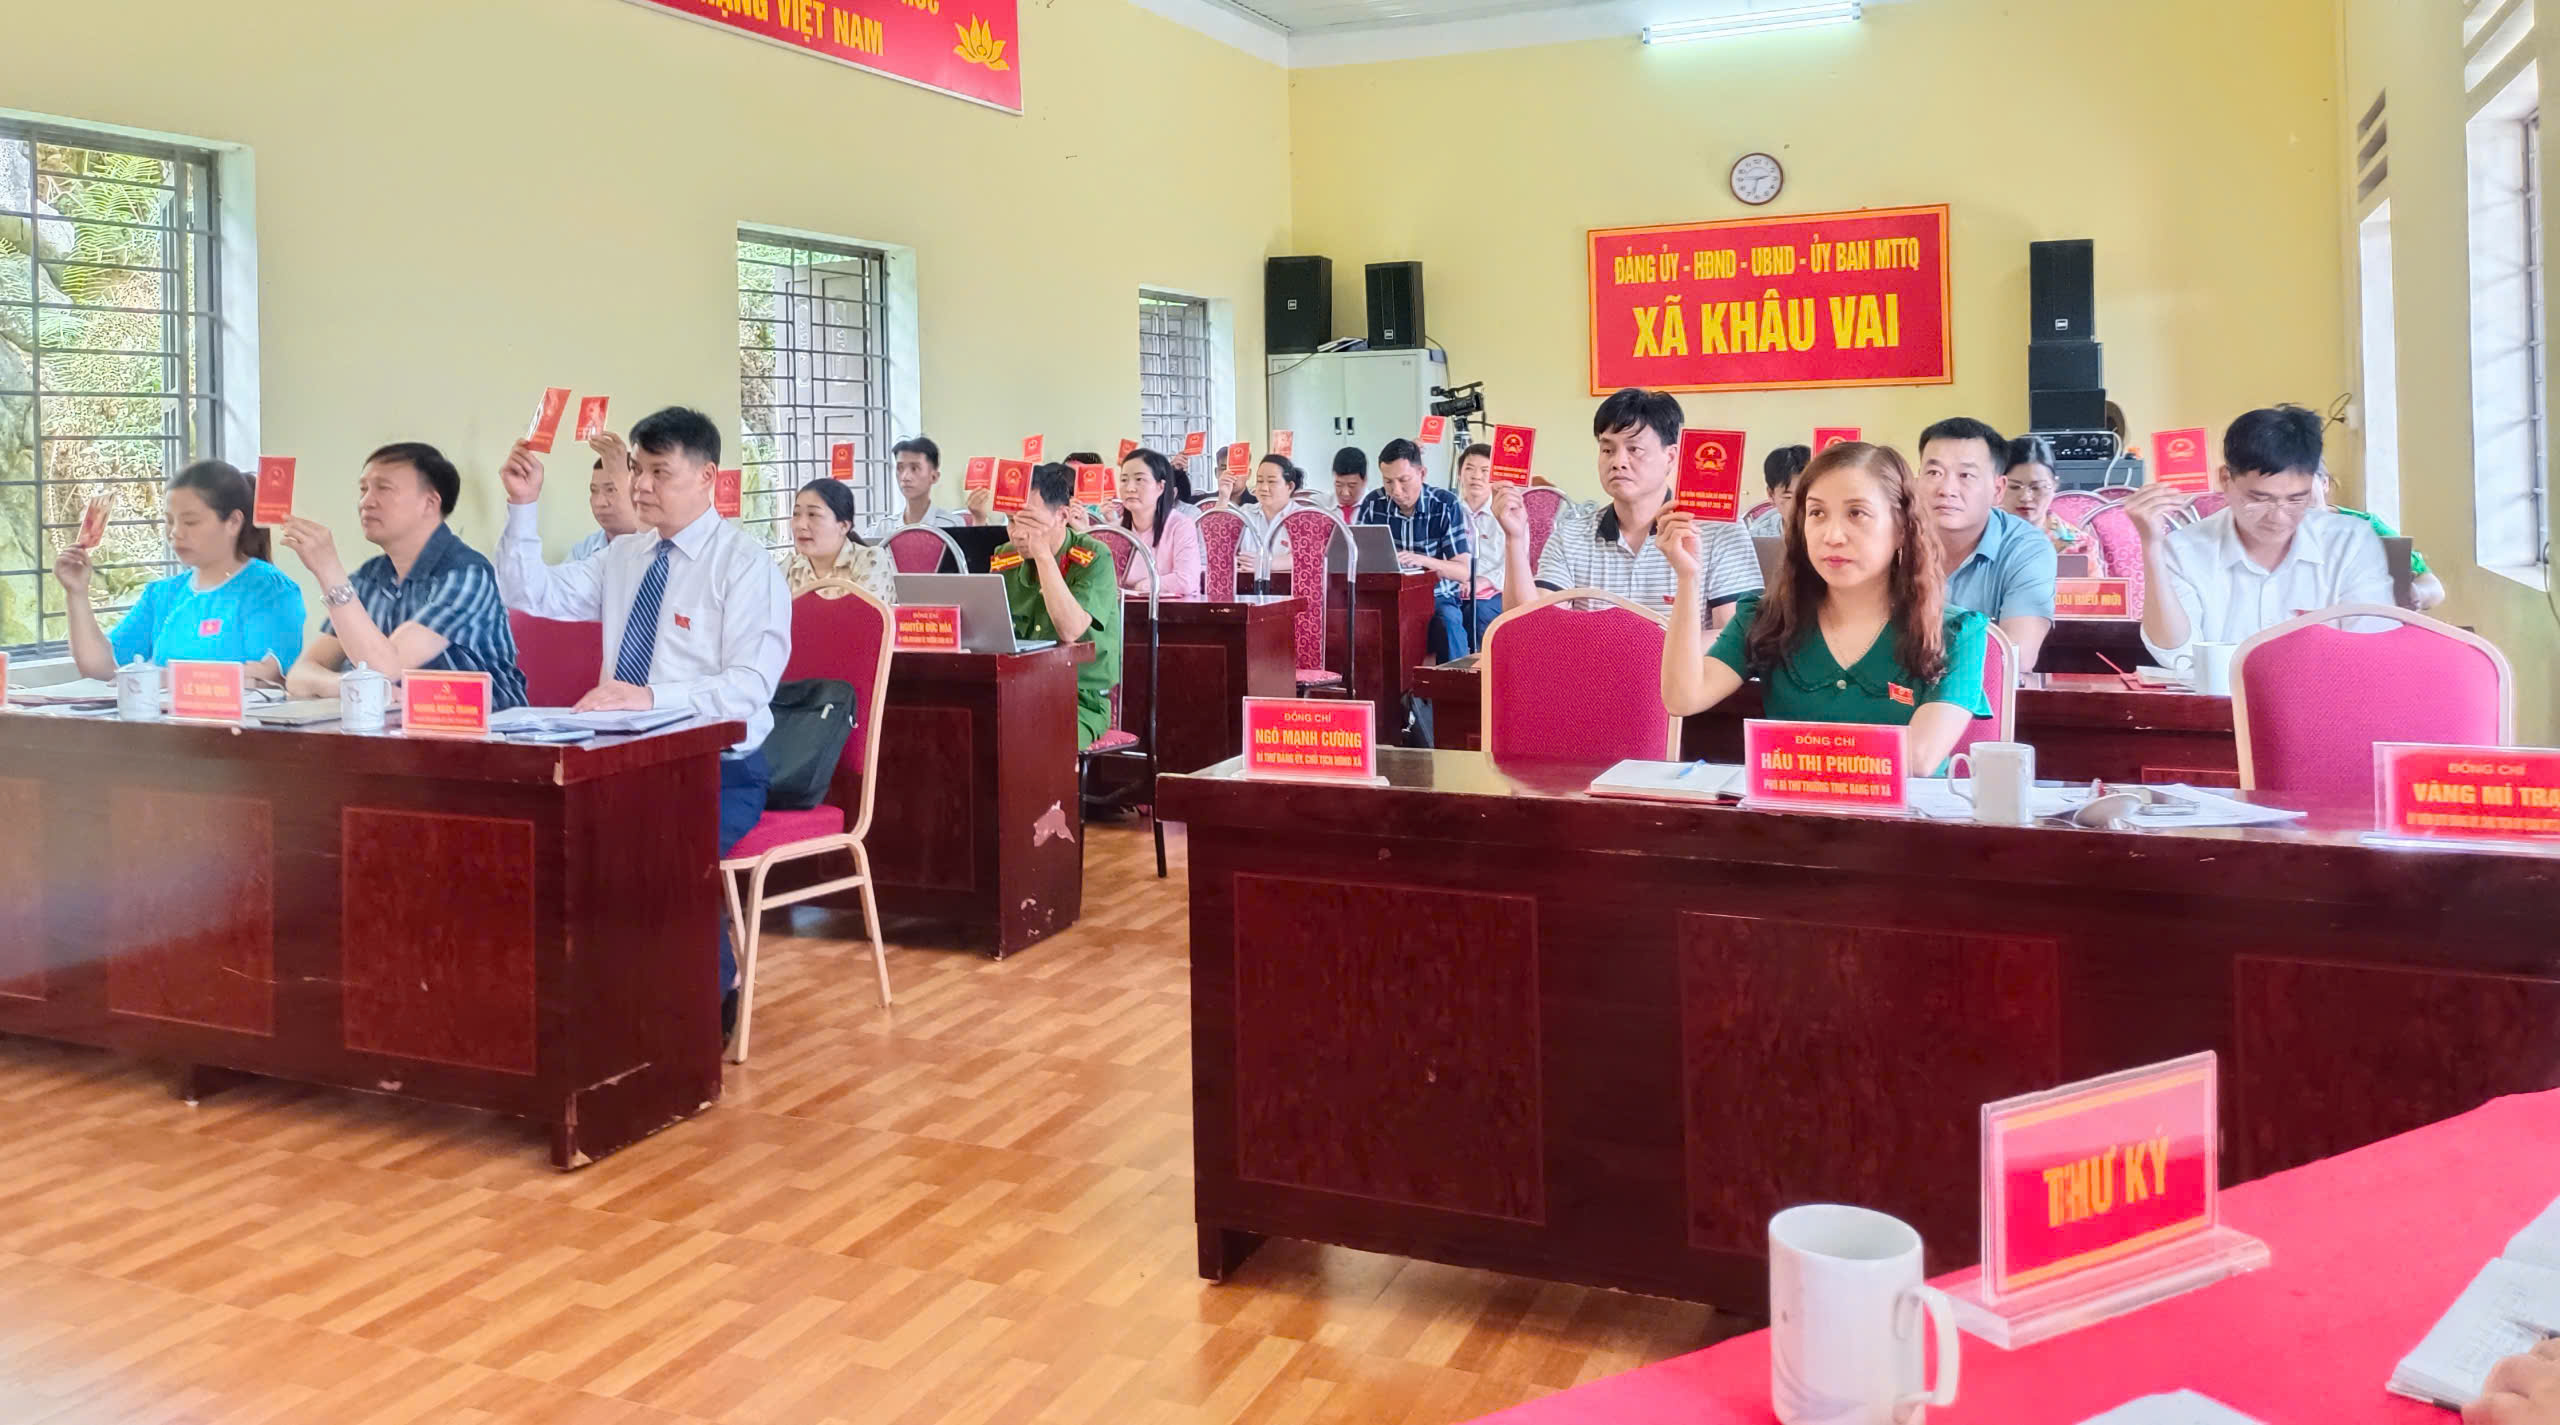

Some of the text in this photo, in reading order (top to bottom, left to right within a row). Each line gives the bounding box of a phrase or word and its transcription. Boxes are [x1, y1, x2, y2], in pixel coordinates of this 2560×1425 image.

[777, 0, 826, 42] VIỆT
[832, 7, 884, 56] NAM
[1614, 246, 1656, 285] ĐẢNG
[1659, 243, 1679, 282] ỦY
[1693, 249, 1737, 280] HĐND
[1751, 245, 1795, 277] UBND
[1810, 234, 1832, 273] ỦY
[1836, 239, 1870, 271] BAN
[1875, 237, 1920, 271] MTTQ
[1632, 289, 1899, 358] XÃ KHÂU VAI
[1314, 712, 1331, 722] CHÍ
[1255, 726, 1362, 748] NGÔ MẠNH CƯỜNG
[1834, 735, 1856, 747] CHÍ
[1798, 754, 1822, 775] THỊ
[1826, 755, 1892, 775] PHƯƠNG
[2043, 1123, 2169, 1228] THƯ KÝ
